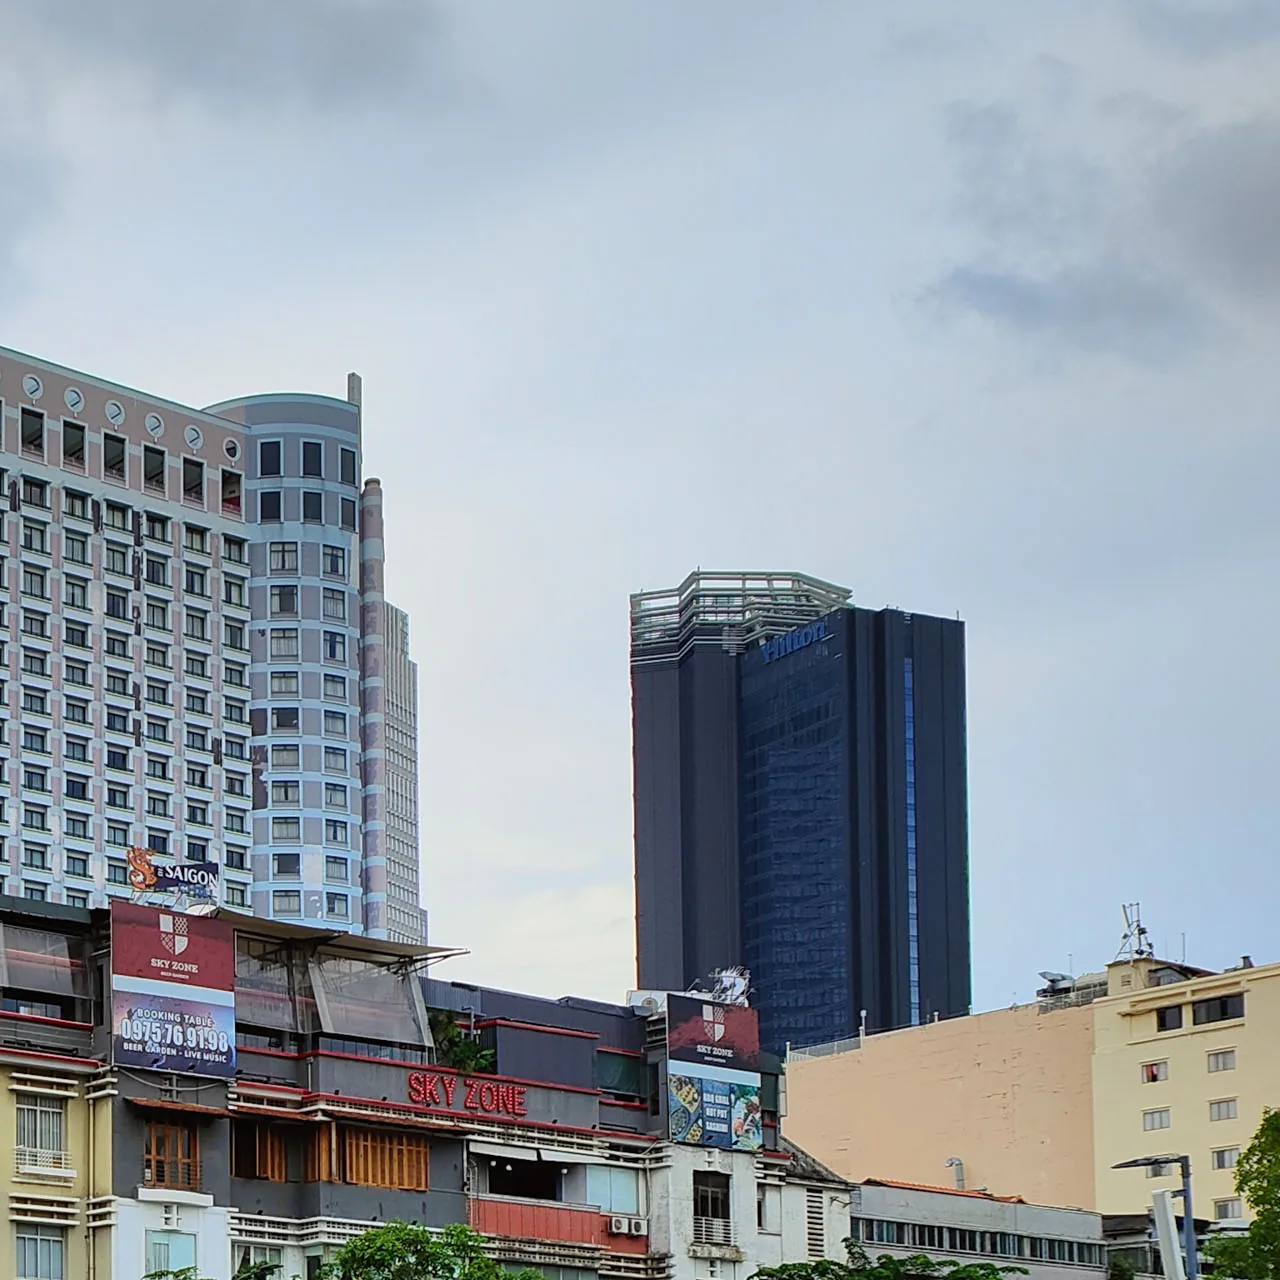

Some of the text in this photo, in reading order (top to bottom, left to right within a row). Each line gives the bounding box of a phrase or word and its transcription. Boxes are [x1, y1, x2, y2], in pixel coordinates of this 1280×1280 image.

[760, 622, 825, 665] Hilton
[165, 864, 218, 888] SAIGON
[151, 958, 199, 973] SKY ZONE
[137, 1008, 212, 1027] BOOKING TABLE
[121, 1018, 229, 1053] 0975.76.91.98
[123, 1042, 143, 1052] BEER
[145, 1044, 177, 1056] GARDEN
[184, 1050, 202, 1060] LIVE
[203, 1052, 228, 1064] MUSIC
[408, 1072, 528, 1115] SKY ZONE
